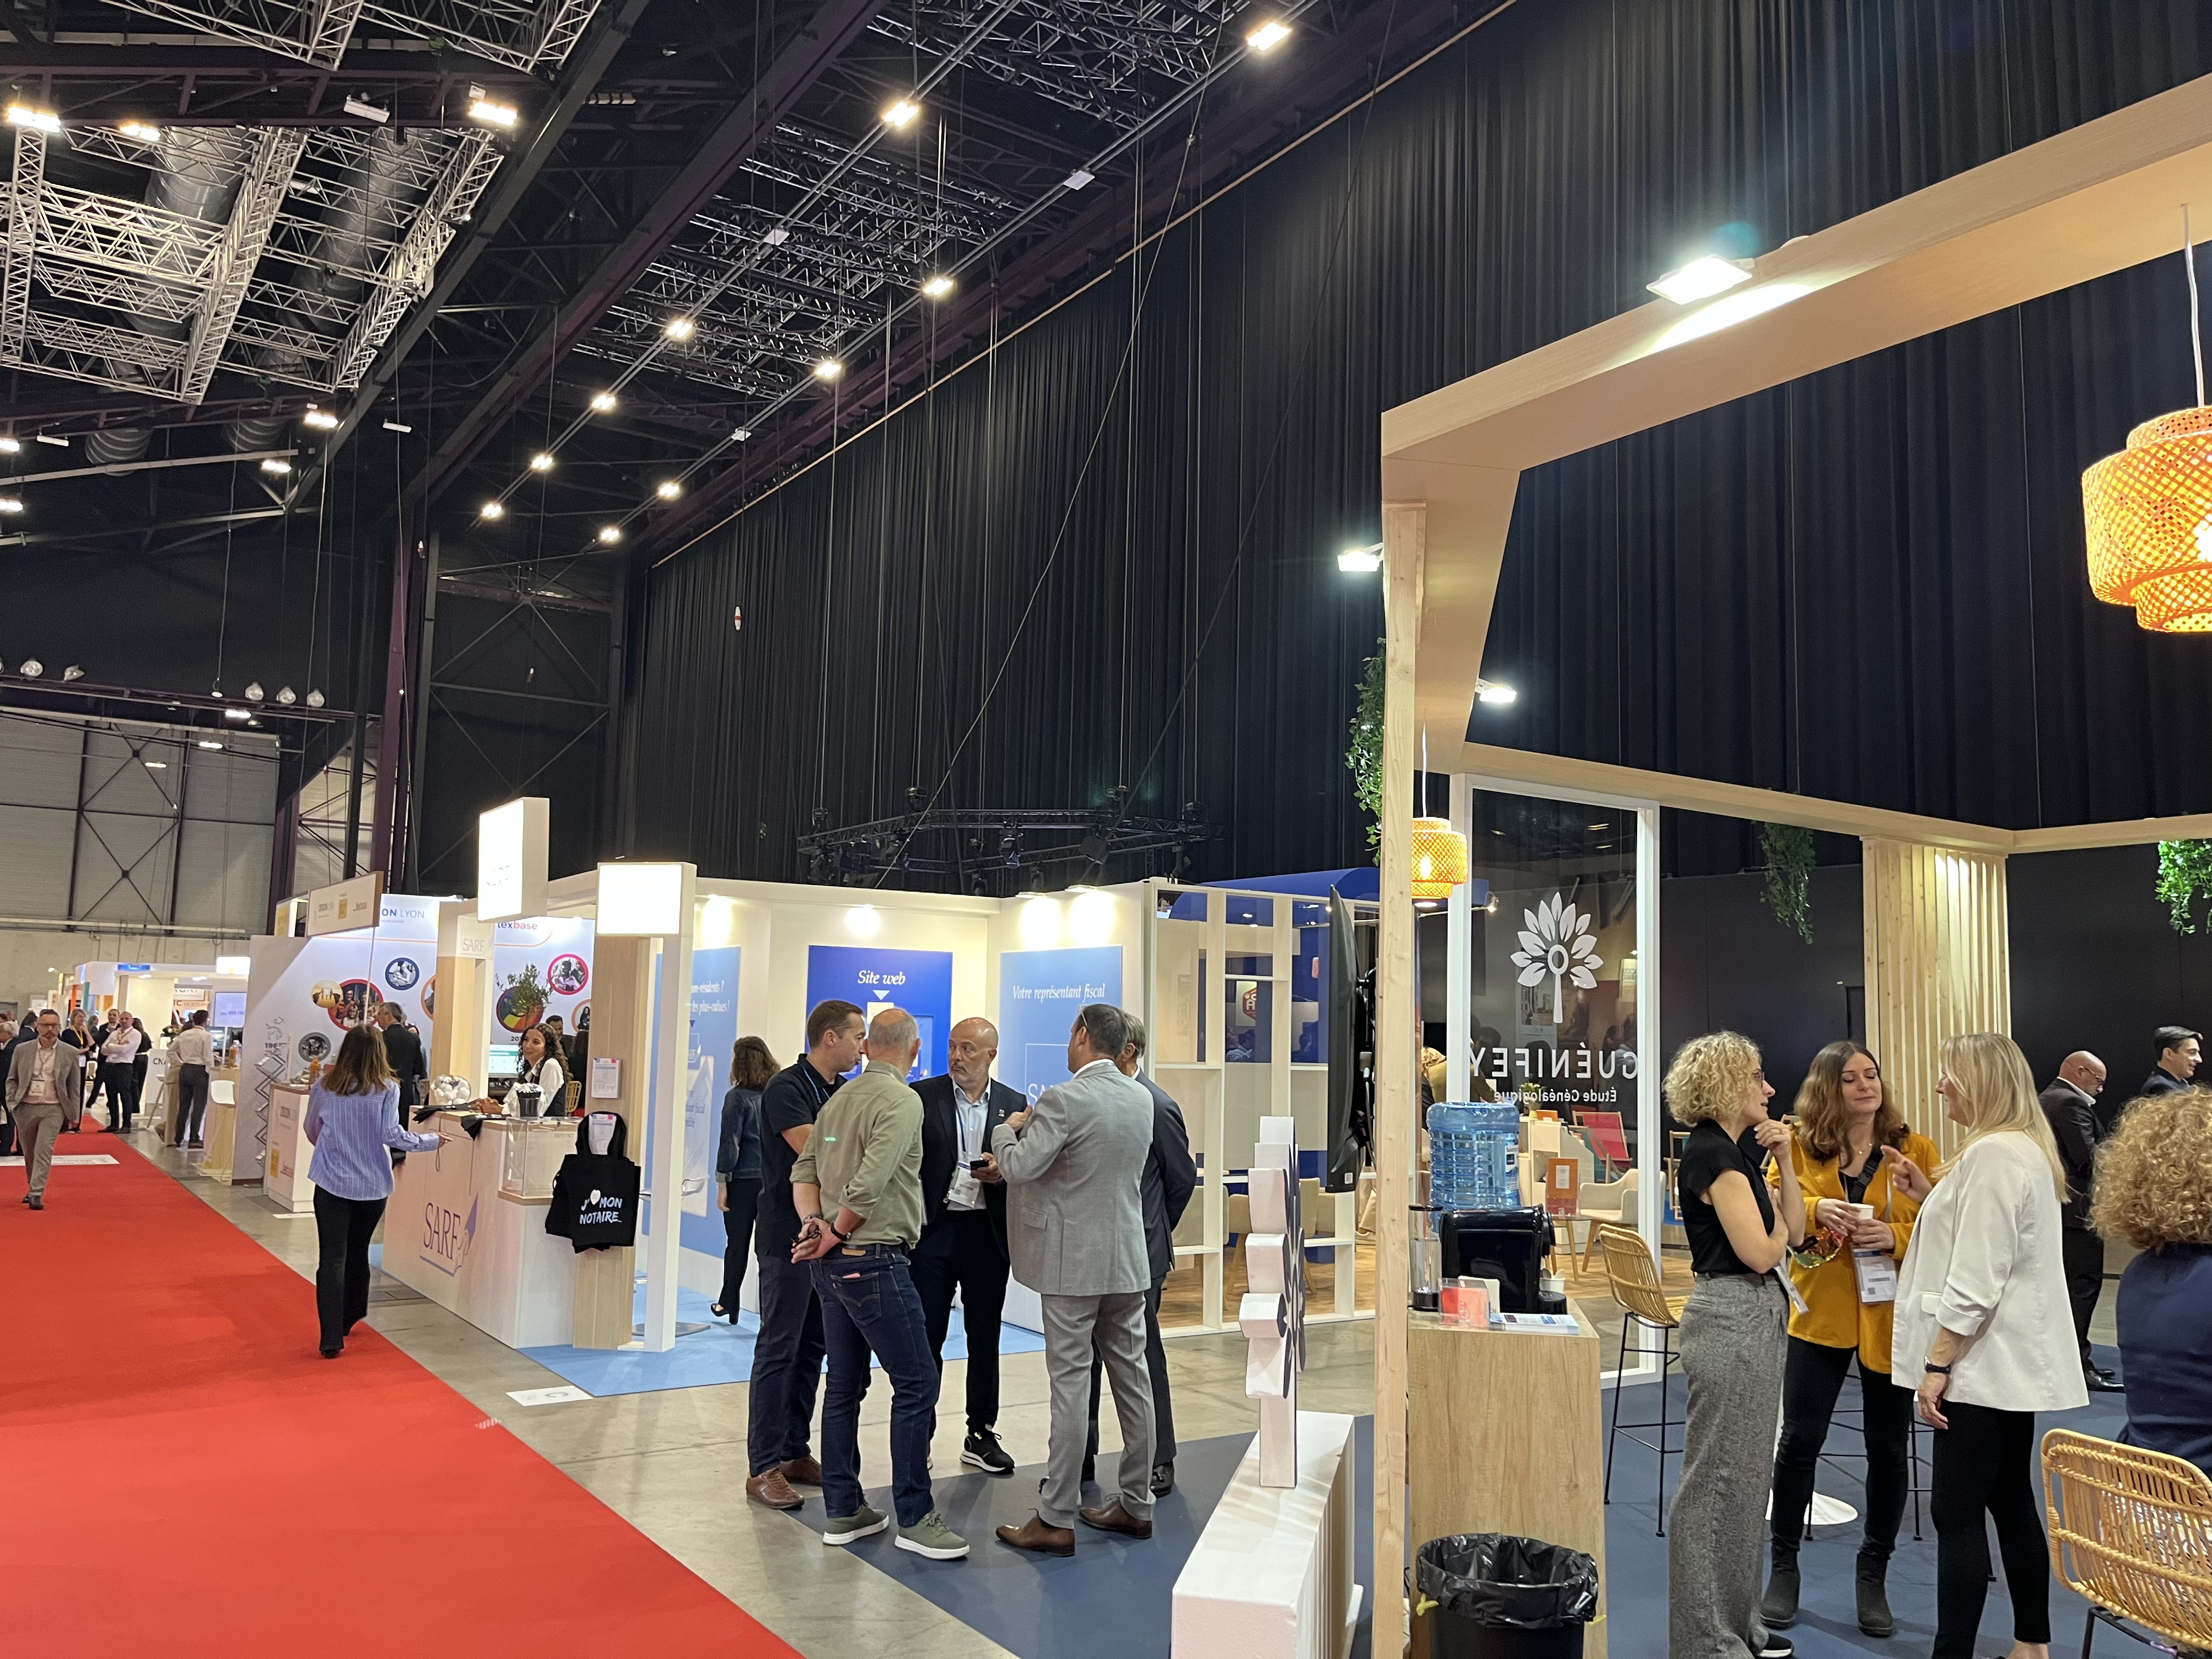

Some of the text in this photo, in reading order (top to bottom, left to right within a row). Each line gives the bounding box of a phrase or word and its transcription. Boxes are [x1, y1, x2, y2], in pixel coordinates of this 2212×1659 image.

[382, 909, 425, 918] ON LYON
[462, 938, 485, 952] SARF
[857, 970, 906, 985] Site web
[1013, 983, 1105, 1003] Votre représentant fiscal
[599, 1197, 623, 1209] MON
[424, 1202, 461, 1261] SARF
